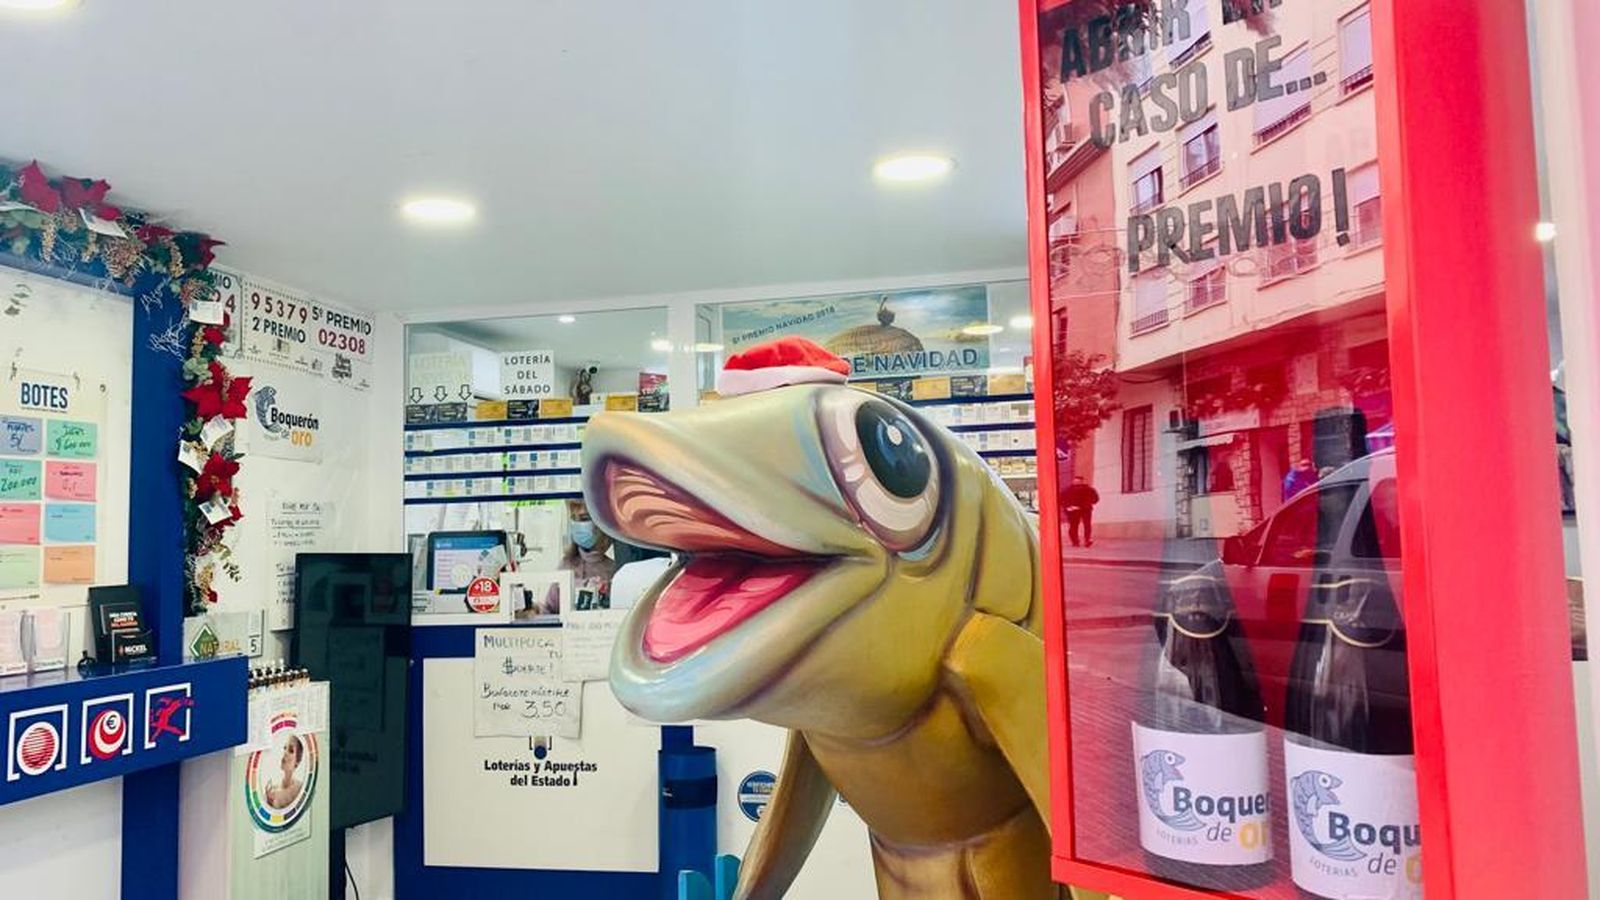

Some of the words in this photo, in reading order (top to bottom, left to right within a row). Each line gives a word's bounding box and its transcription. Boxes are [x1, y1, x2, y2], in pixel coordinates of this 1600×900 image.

[1088, 60, 1209, 150] CASO
[250, 292, 308, 324] 95379
[252, 316, 262, 331] 2
[263, 320, 307, 344] PREMIO
[326, 310, 372, 336] PREMIO
[742, 325, 775, 341] PREMIO
[775, 313, 815, 331] NAVIDAD
[318, 328, 366, 355] 02308
[504, 354, 551, 366] LOTERÍA
[874, 348, 978, 372] NAVIDAD
[516, 370, 538, 380] DEL
[20, 382, 69, 409] BOTES
[503, 384, 551, 395] SÁBADO
[270, 406, 319, 431] Boquerón
[291, 430, 312, 447] oro
[474, 580, 493, 593] +18
[484, 759, 530, 773] Loterías
[533, 762, 542, 775] y
[544, 759, 598, 775] Apuestas
[509, 774, 528, 787] del
[531, 774, 571, 787] Estado
[1206, 821, 1233, 842] de
[1328, 810, 1422, 856] Boqu
[1367, 852, 1397, 875] de
